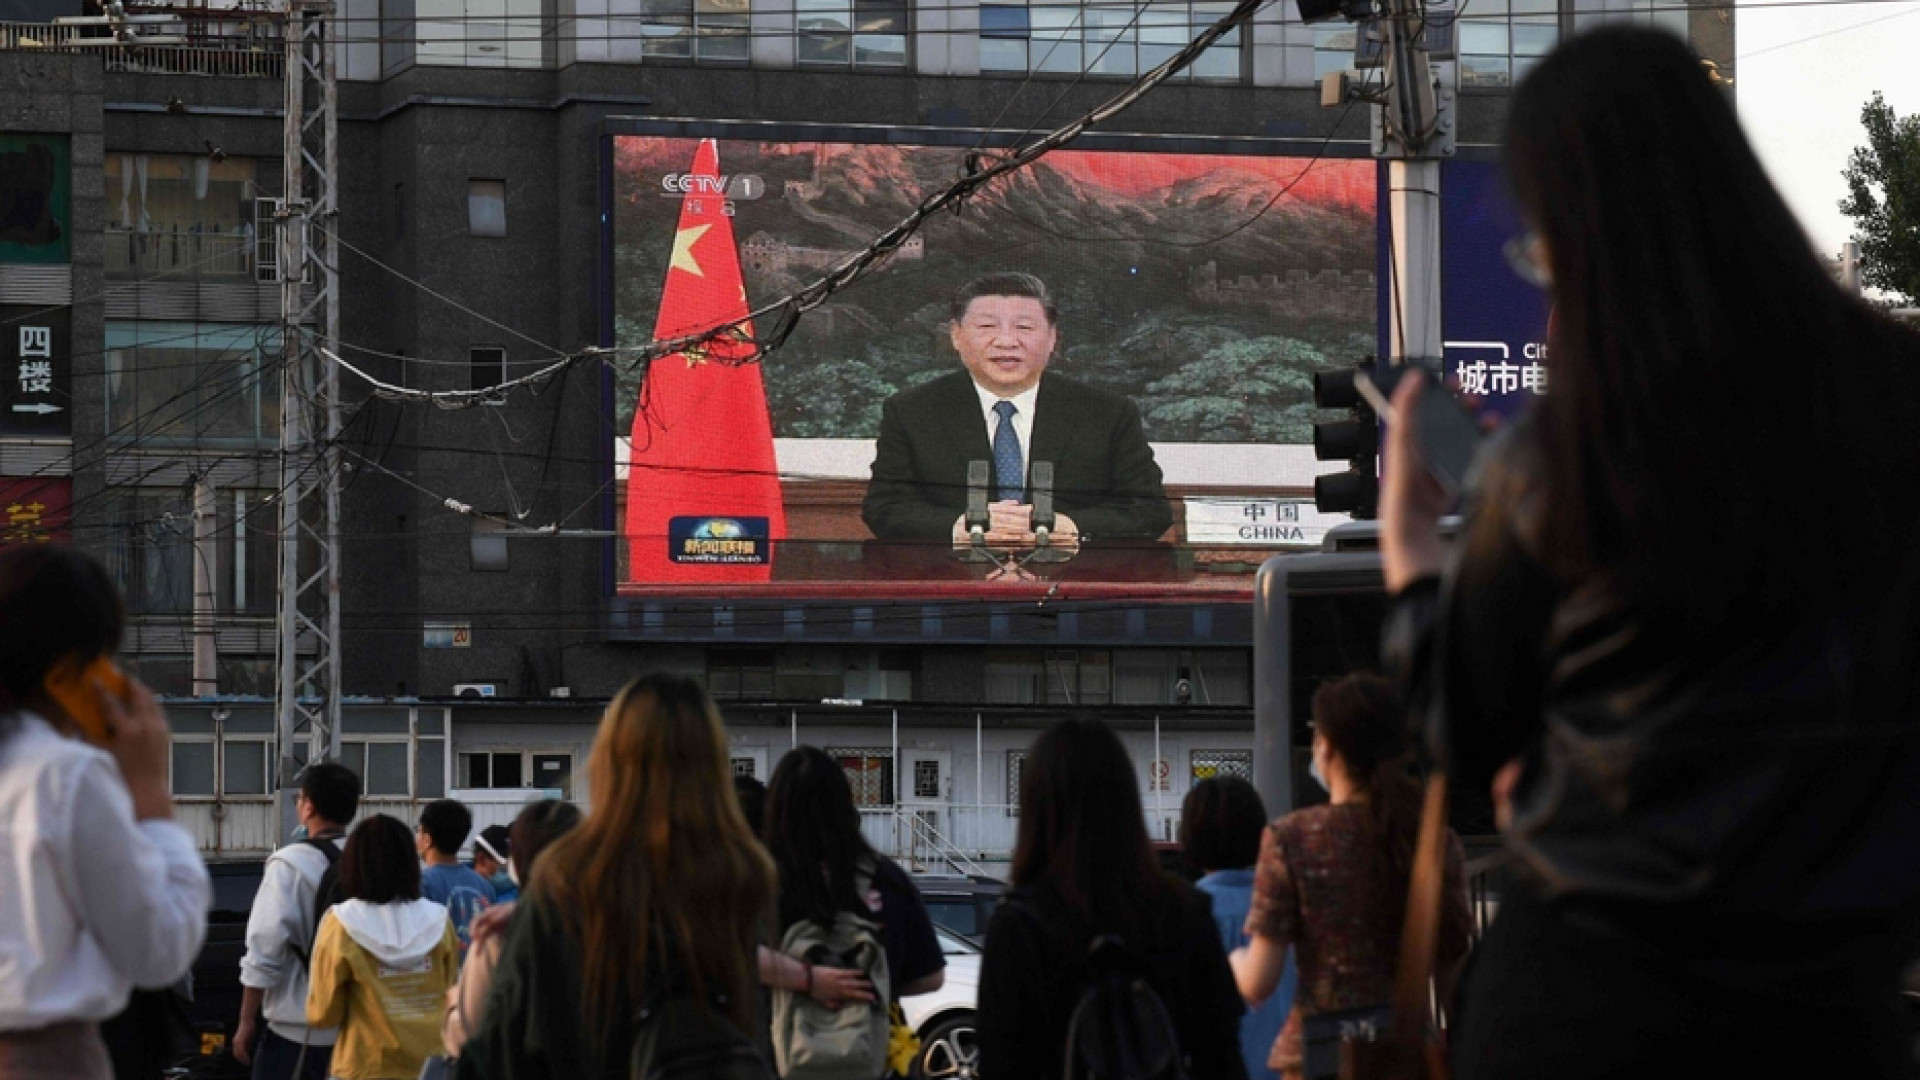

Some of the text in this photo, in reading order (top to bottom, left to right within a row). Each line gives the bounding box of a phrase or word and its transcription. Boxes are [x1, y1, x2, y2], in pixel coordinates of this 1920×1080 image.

[662, 173, 752, 197] CCTV 1
[18, 325, 52, 393] 四楼
[1244, 503, 1299, 522] 中国
[1238, 526, 1304, 540] CHINA
